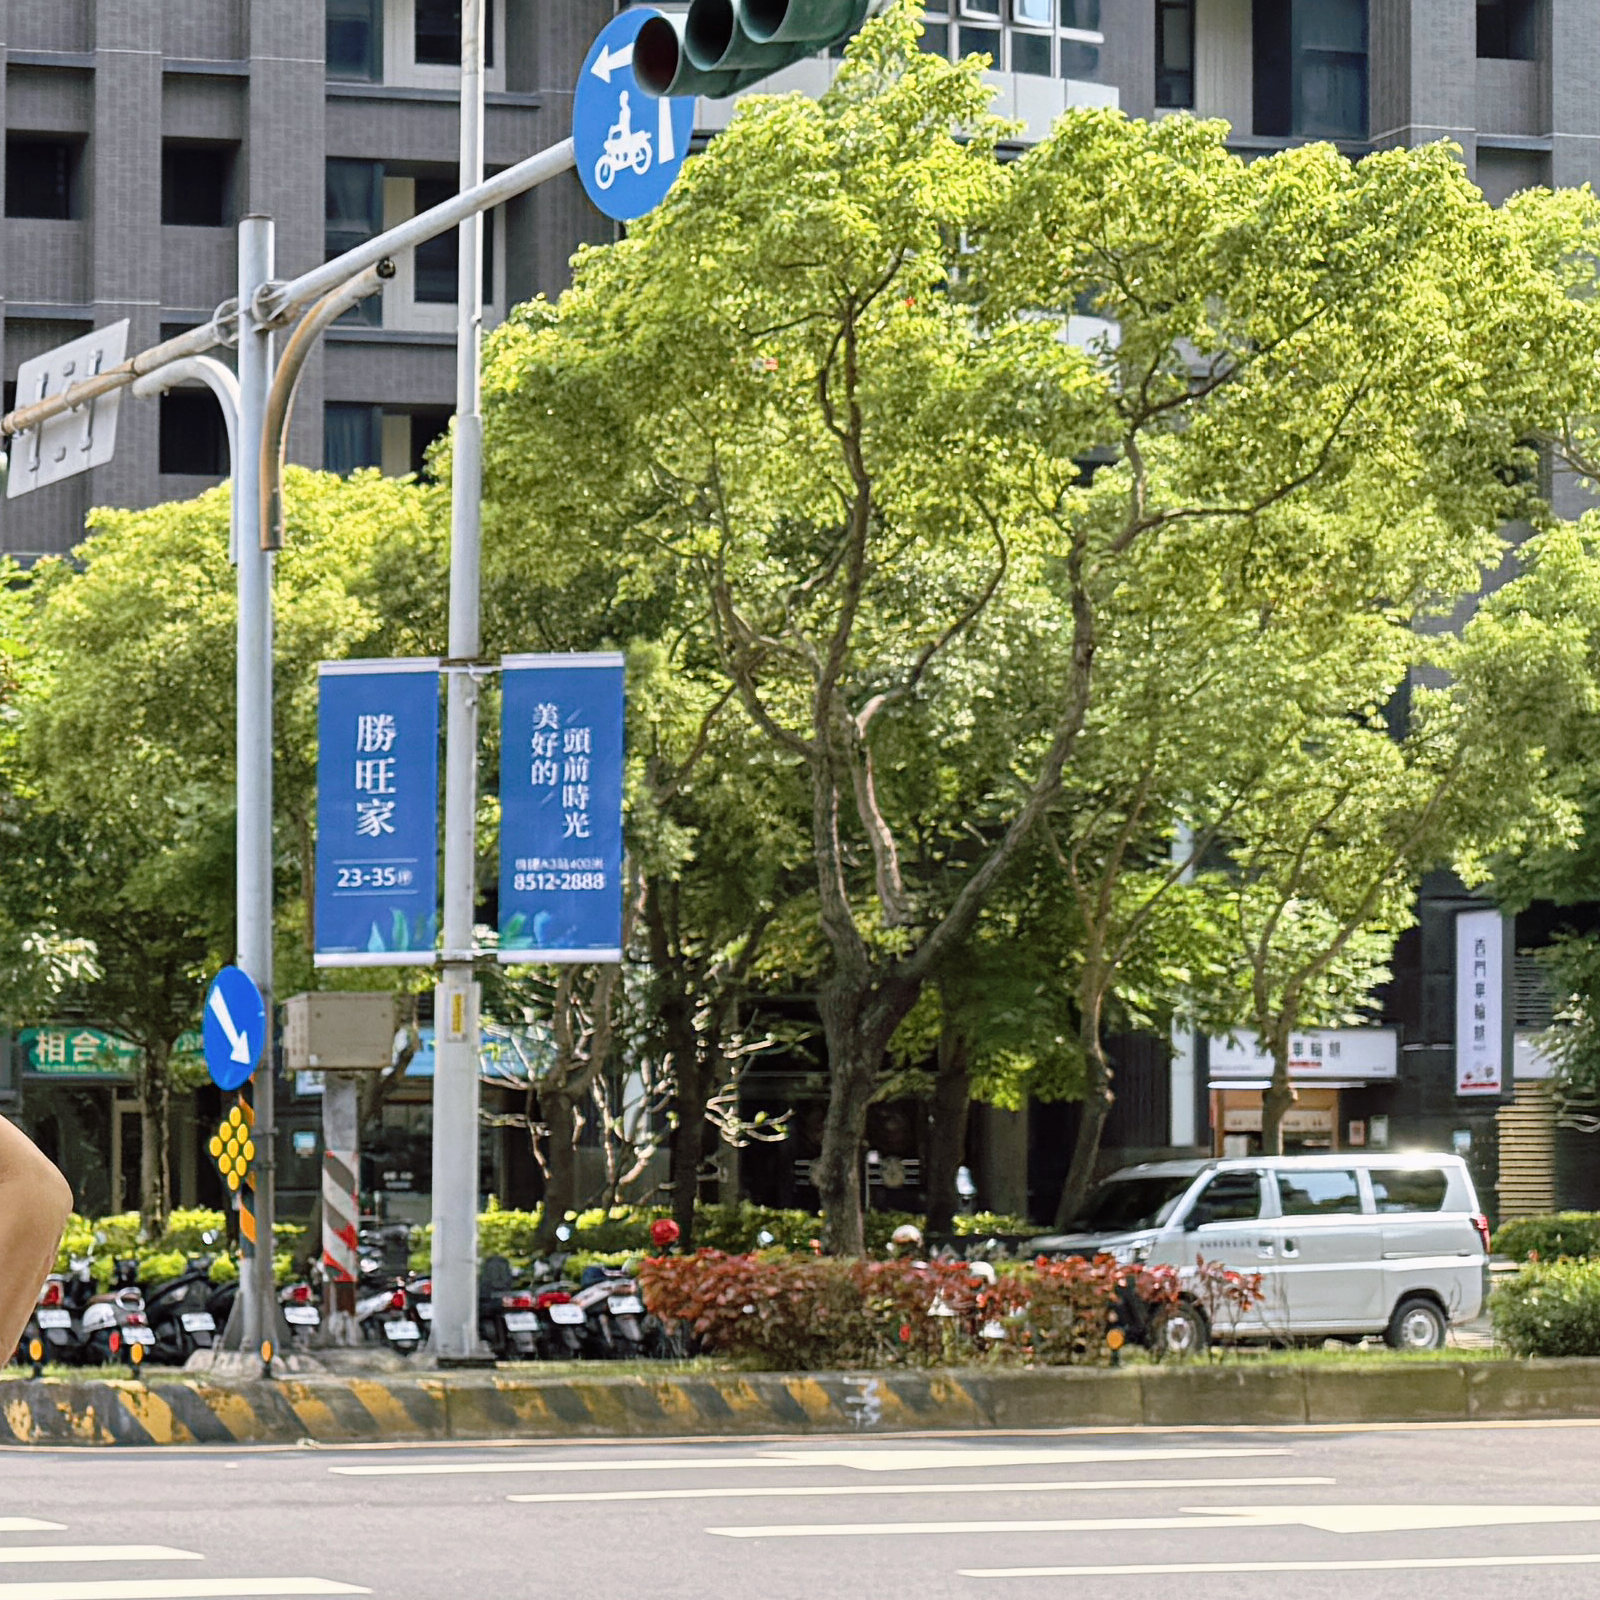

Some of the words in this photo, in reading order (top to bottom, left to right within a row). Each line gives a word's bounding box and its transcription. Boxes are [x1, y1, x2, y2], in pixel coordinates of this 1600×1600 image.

[356, 714, 397, 837] 勝旺家
[531, 703, 559, 786] 美好的
[562, 727, 591, 839] 頭前時光
[514, 873, 606, 891] 8512-2888
